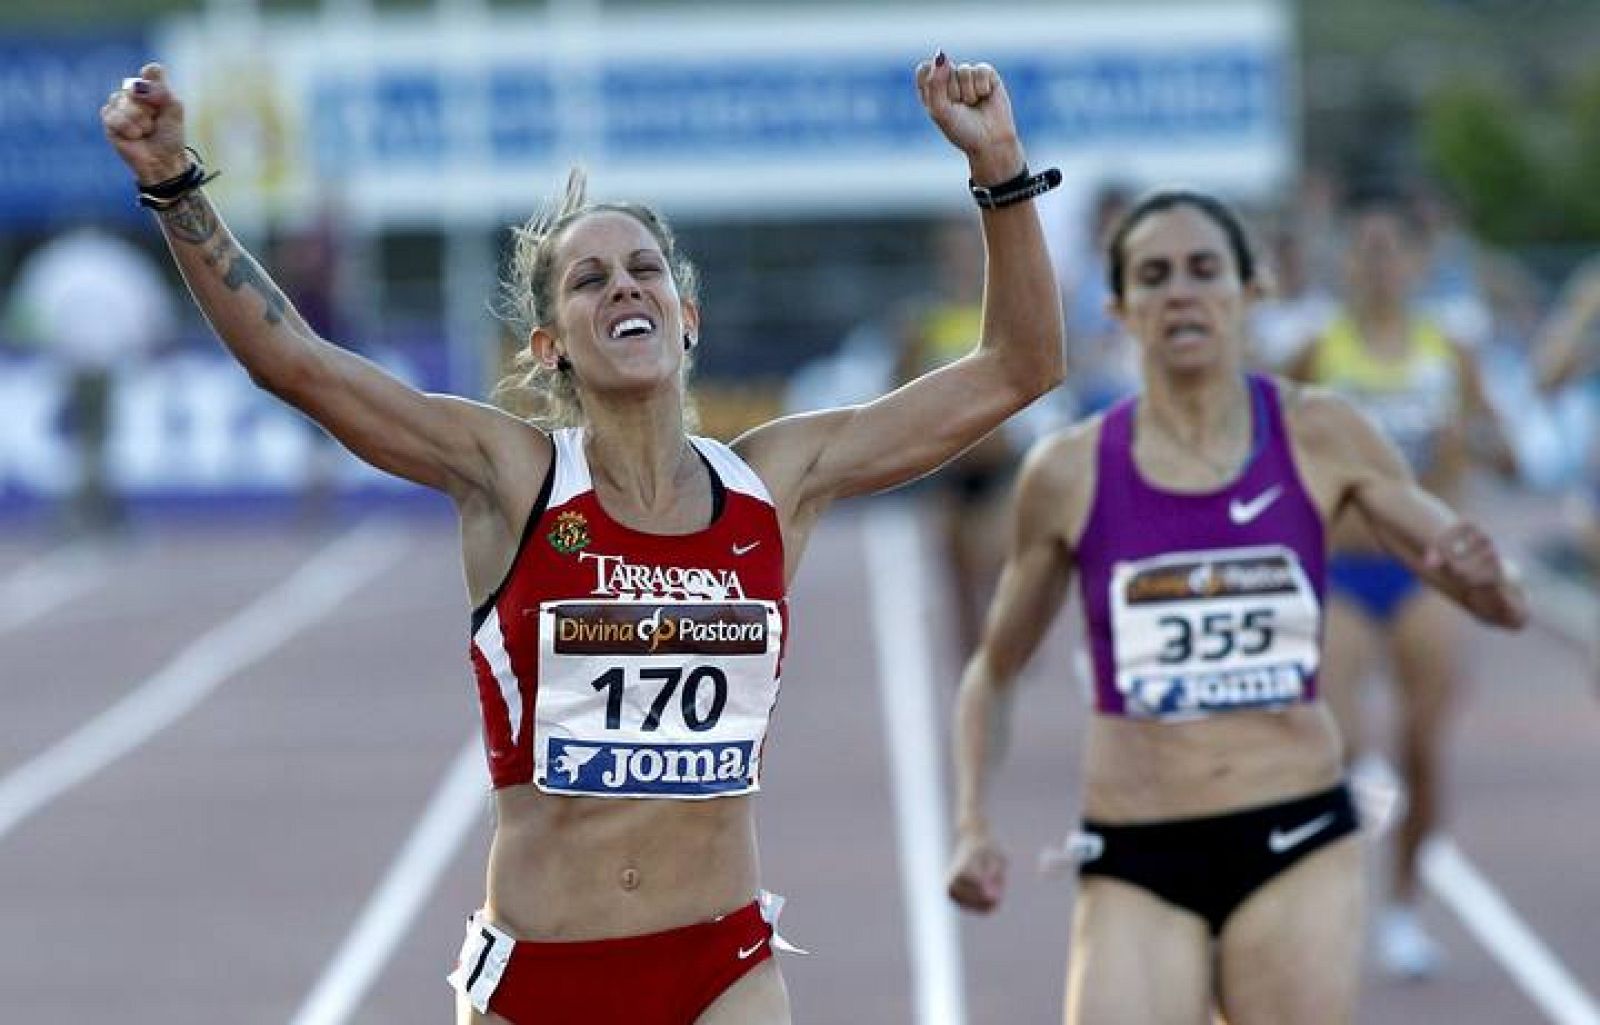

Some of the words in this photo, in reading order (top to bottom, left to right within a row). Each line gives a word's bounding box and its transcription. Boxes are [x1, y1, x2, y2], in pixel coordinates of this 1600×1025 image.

[560, 618, 634, 641] Divina
[679, 618, 763, 641] Pastora
[1157, 609, 1275, 664] 355
[590, 665, 727, 732] 170
[602, 747, 744, 788] Joma
